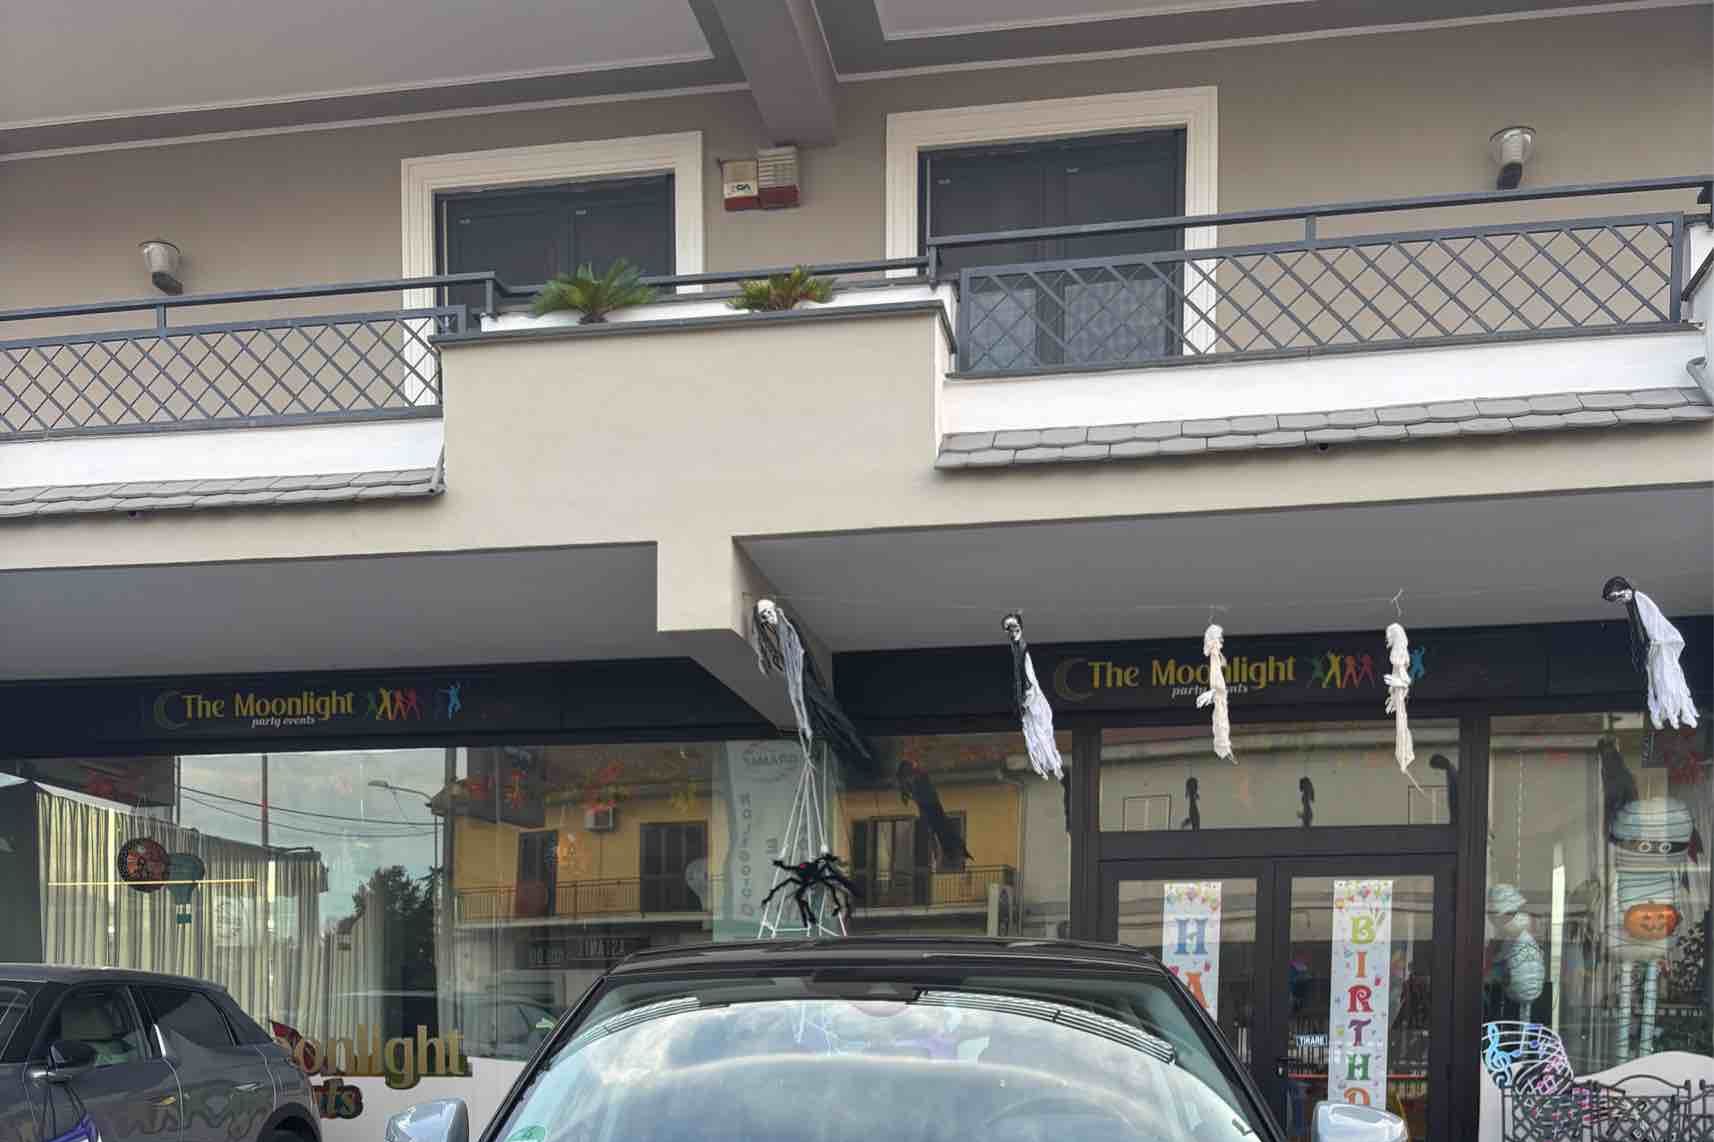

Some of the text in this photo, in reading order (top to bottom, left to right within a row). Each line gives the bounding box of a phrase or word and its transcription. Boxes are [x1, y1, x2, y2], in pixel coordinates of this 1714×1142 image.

[1088, 661, 1140, 689] The
[181, 690, 355, 721] The Moonlight
[251, 715, 316, 729] party events
